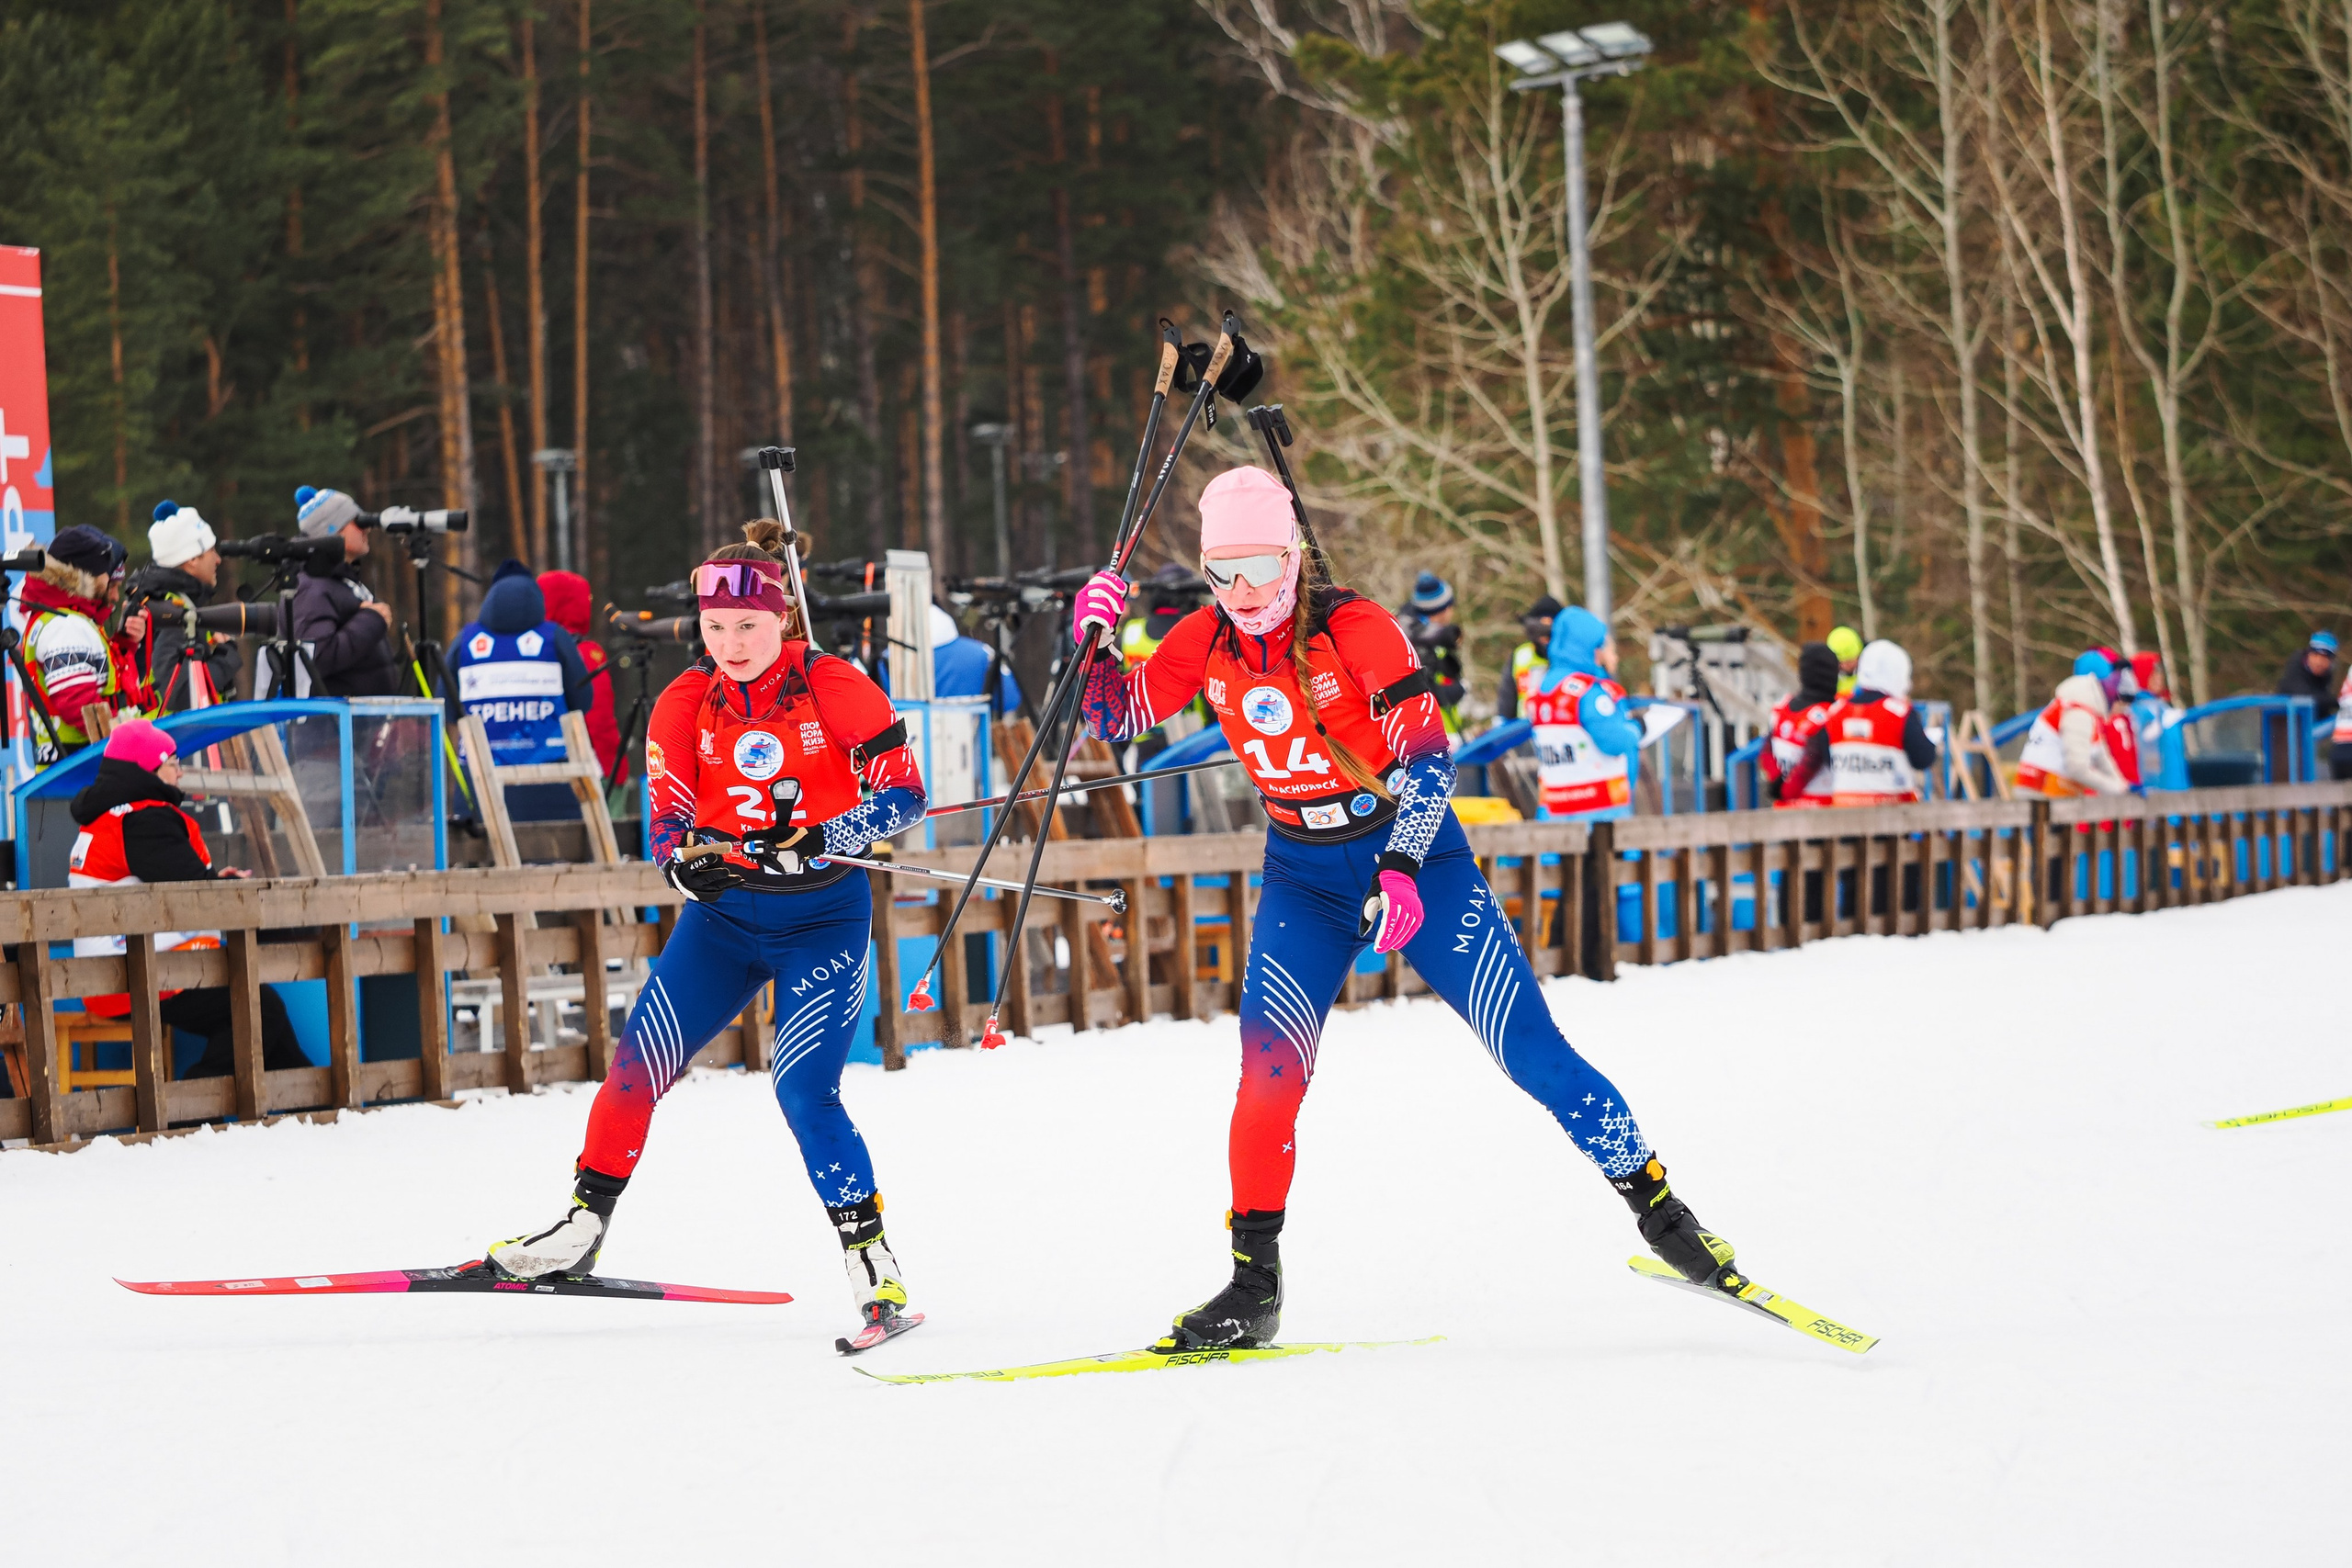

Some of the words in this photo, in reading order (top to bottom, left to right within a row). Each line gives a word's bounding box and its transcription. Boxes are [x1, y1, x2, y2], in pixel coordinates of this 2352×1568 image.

[1158, 454, 1174, 480] MOAX
[1108, 550, 1121, 572] MOA
[1312, 678, 1338, 694] ОРМА
[469, 701, 555, 723] ТРЕНЕР
[799, 721, 820, 731] СПОР
[802, 737, 827, 748] ЖИЗН
[1243, 737, 1331, 779] 14
[1385, 918, 1396, 940] MOAX
[1453, 884, 1487, 953] MOAX
[791, 949, 855, 998] MOAX
[1615, 1181, 1634, 1190] 164
[838, 1210, 858, 1222] 172
[492, 1283, 529, 1292] ATOMIC
[1806, 1318, 1864, 1348] FISCHER
[1164, 1351, 1230, 1367] FISCHER
